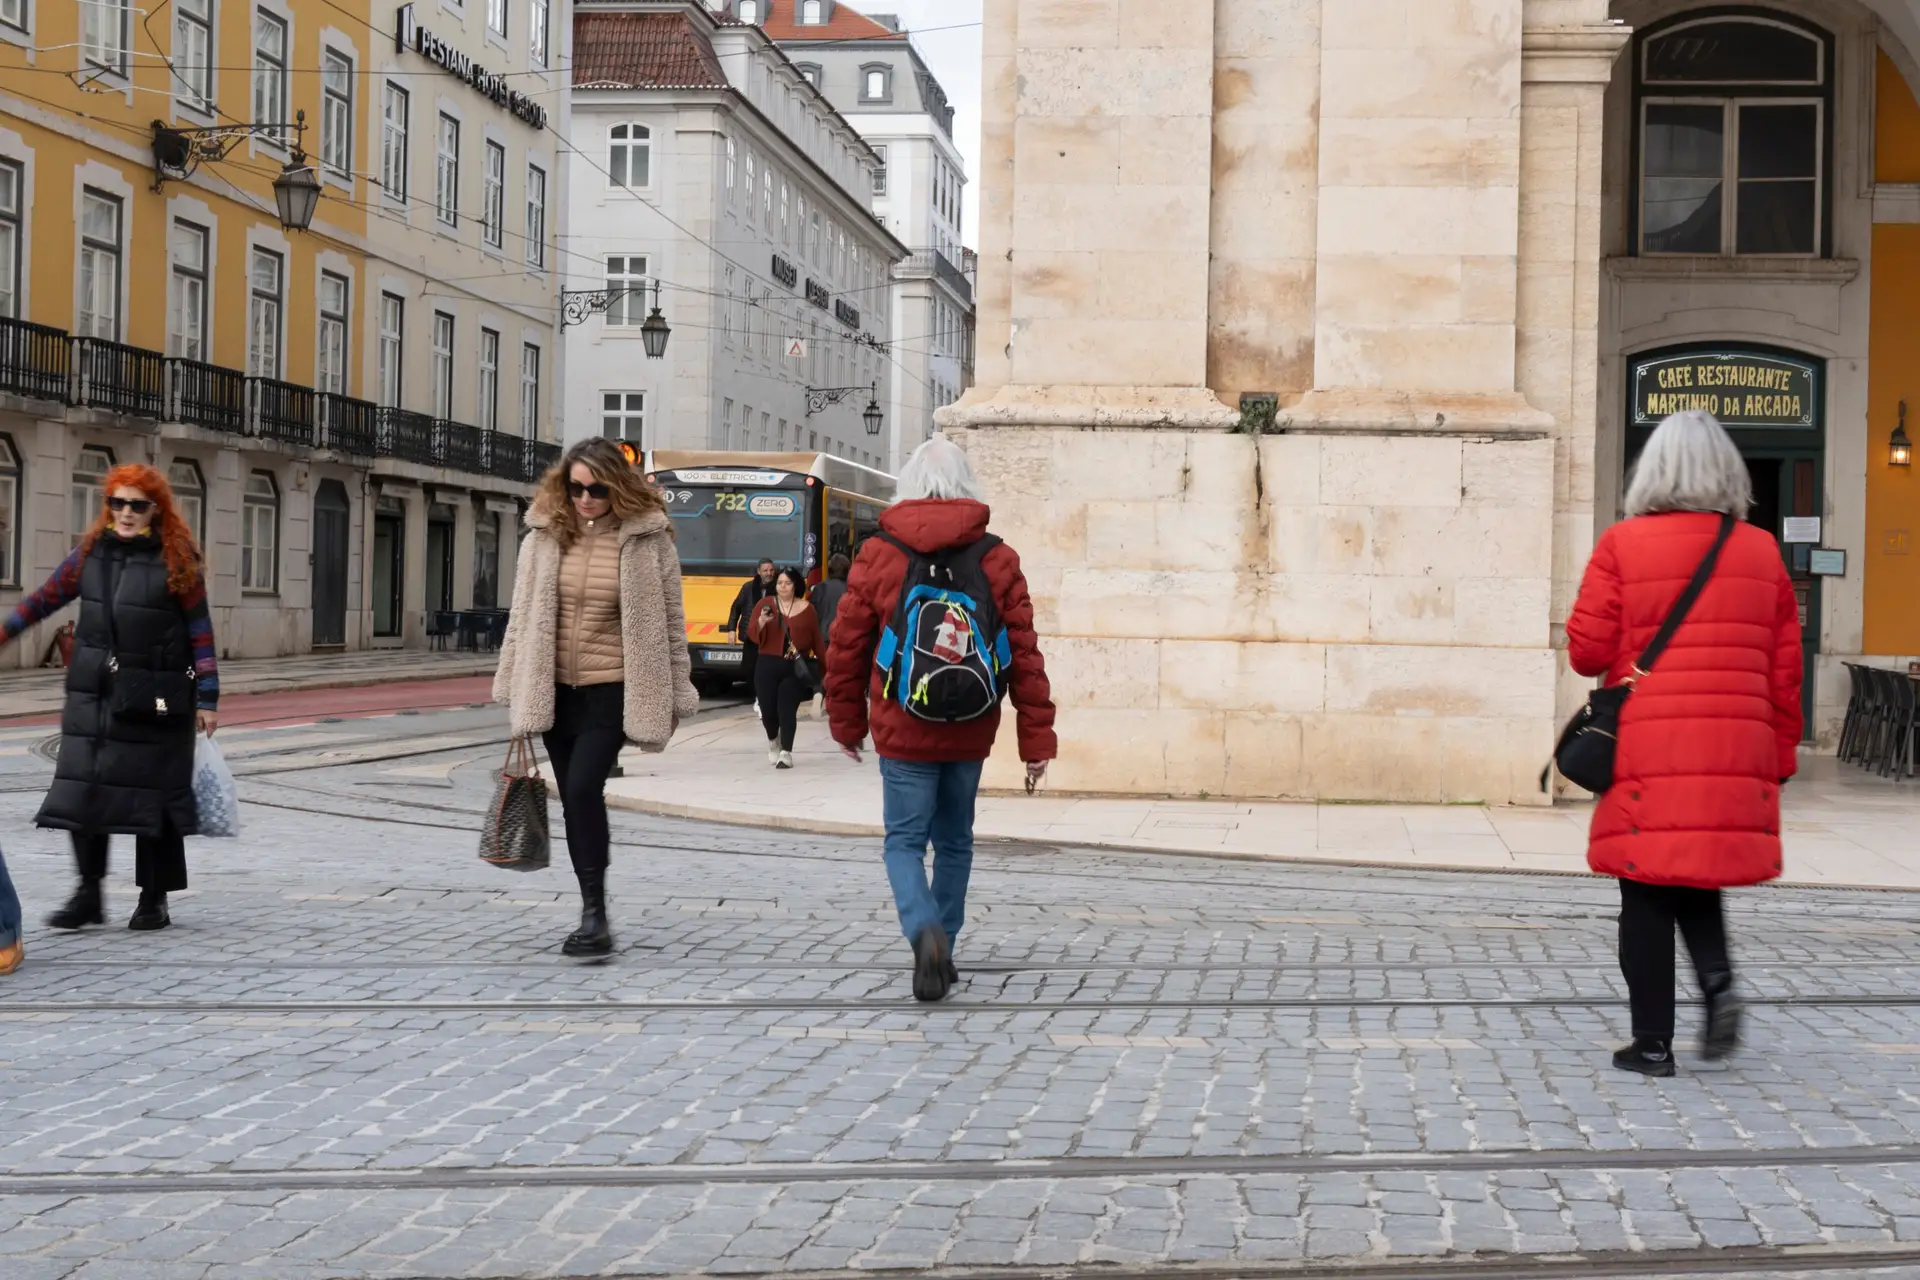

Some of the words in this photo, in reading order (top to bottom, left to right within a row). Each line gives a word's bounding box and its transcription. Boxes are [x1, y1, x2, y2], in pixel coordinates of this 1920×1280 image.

[417, 27, 474, 84] PESTANA
[511, 90, 548, 129] GROUP
[1658, 364, 1693, 388] CAFÉ
[1698, 365, 1792, 391] RESTAURANTE
[1647, 393, 1719, 416] MARTINHO
[1723, 397, 1740, 416] DA
[1744, 395, 1801, 417] ARCADA
[710, 473, 757, 481] ELÉTRICO
[714, 493, 747, 511] 732
[756, 499, 787, 507] ZERO
